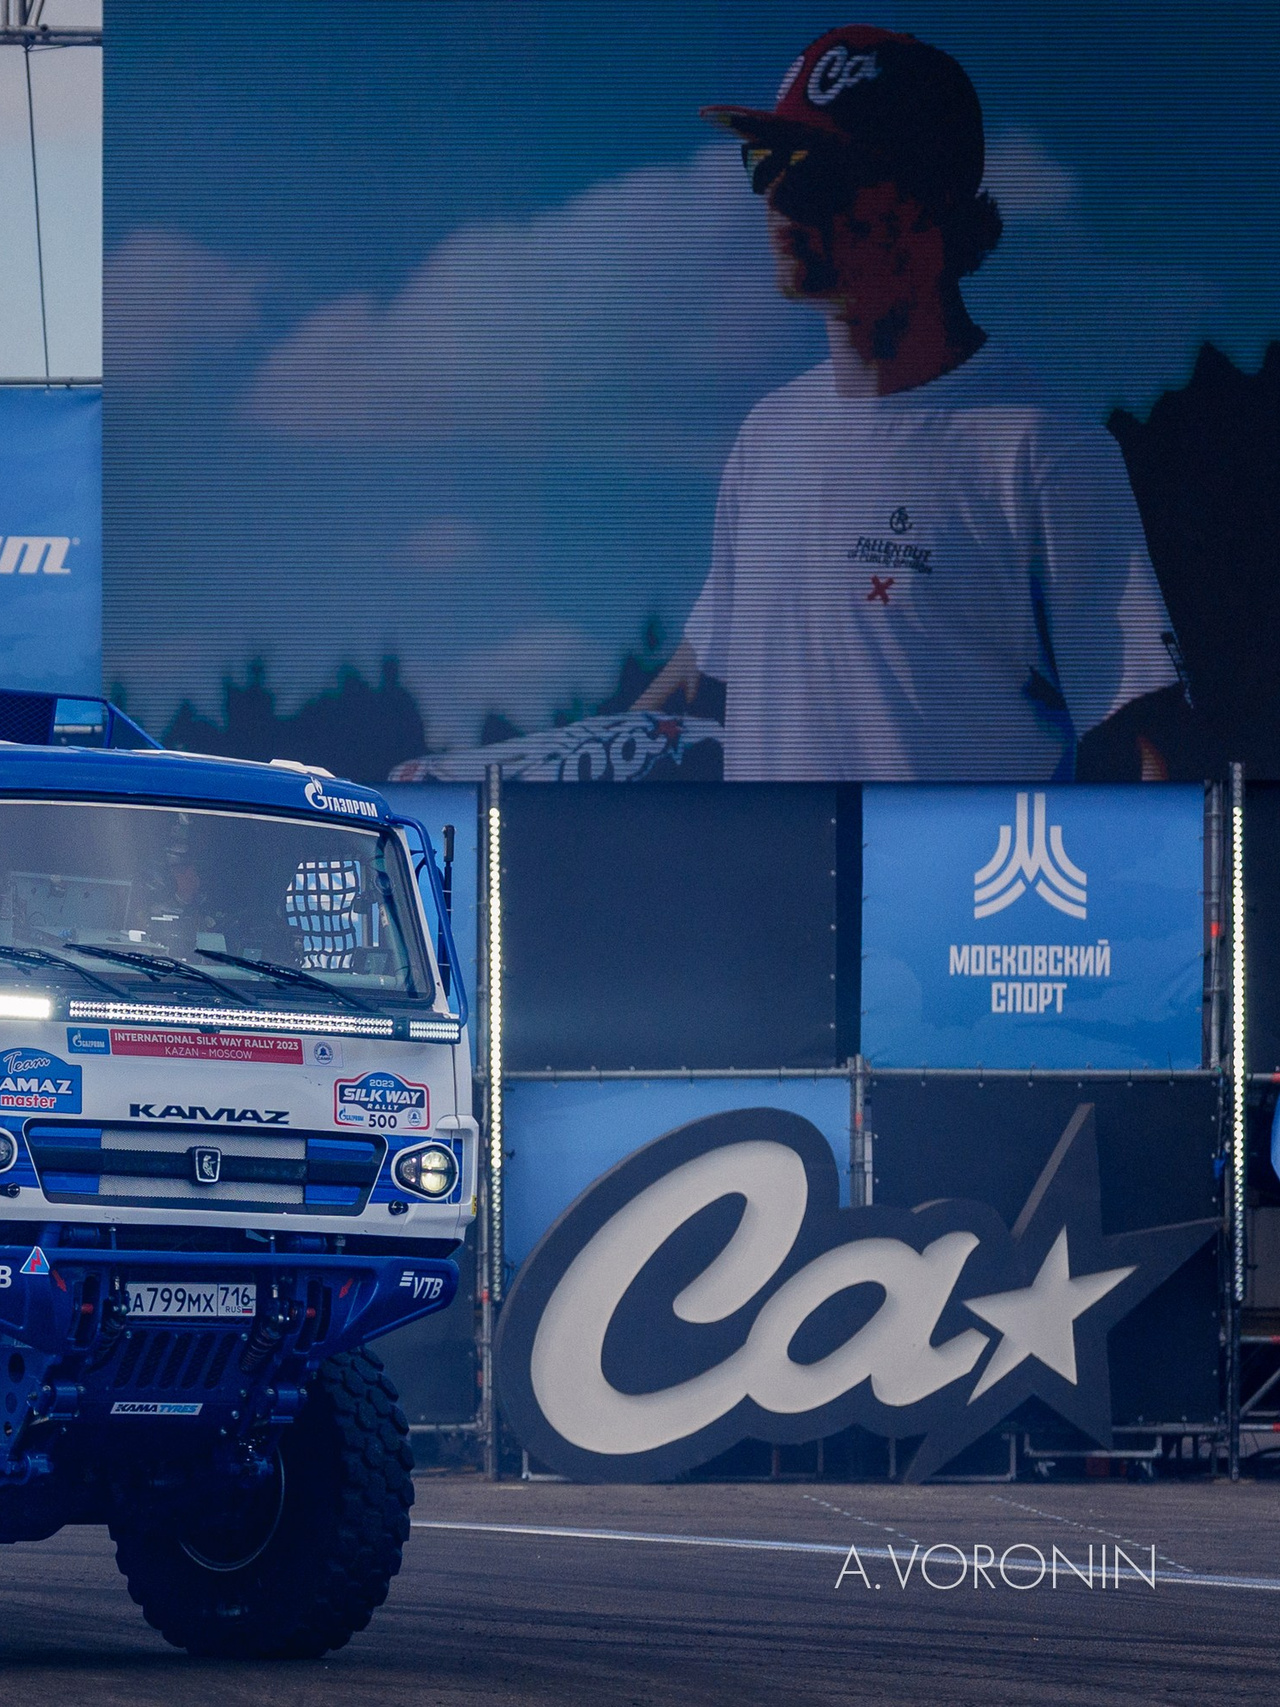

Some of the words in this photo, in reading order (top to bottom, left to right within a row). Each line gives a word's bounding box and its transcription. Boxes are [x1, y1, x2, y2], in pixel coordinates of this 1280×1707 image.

[328, 796, 378, 818] ГАЗПРОМ
[949, 939, 1111, 977] МОСКОВСКИЙ
[991, 982, 1067, 1014] СПОРТ
[114, 1032, 194, 1045] INTERNATIONAL
[196, 1036, 218, 1046] SILK
[220, 1037, 242, 1047] WAY
[244, 1039, 274, 1049] RALLY
[276, 1040, 299, 1050] 2023
[165, 1046, 199, 1056] KAZAN
[209, 1048, 252, 1059] MOSCOW
[3, 1051, 51, 1074] Team
[369, 1079, 395, 1087] 2023
[0, 1094, 57, 1109] master
[343, 1088, 383, 1102] SILK
[386, 1090, 421, 1104] WAY
[130, 1104, 289, 1125] KAMAZ
[368, 1114, 398, 1128] 500
[413, 1276, 443, 1299] VTB
